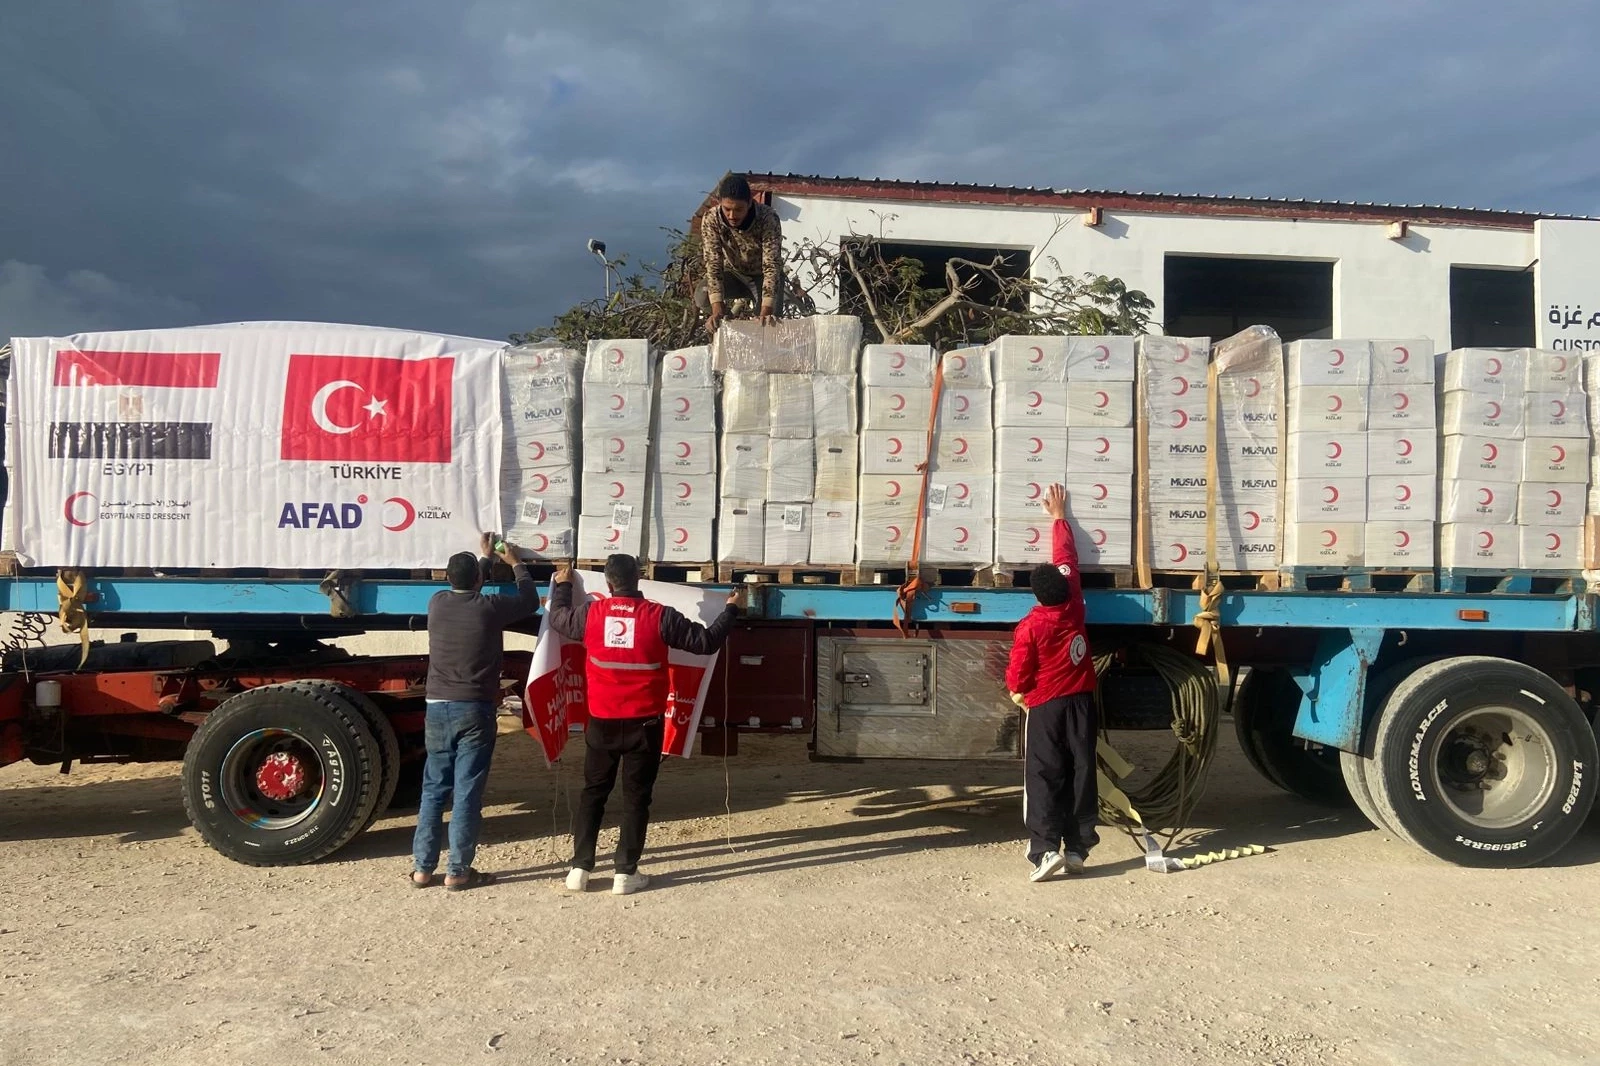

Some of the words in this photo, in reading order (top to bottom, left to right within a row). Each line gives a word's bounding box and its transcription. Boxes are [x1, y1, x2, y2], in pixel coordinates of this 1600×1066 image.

[1549, 305, 1582, 329] غزة
[102, 463, 154, 476] EGYPT
[330, 464, 402, 480] TÜRKİYE
[278, 502, 363, 529] AFAD
[417, 511, 452, 519] KIZILAY
[1408, 698, 1449, 801] LONGMARCH
[327, 750, 341, 792] Agate
[1562, 759, 1583, 815] LM288
